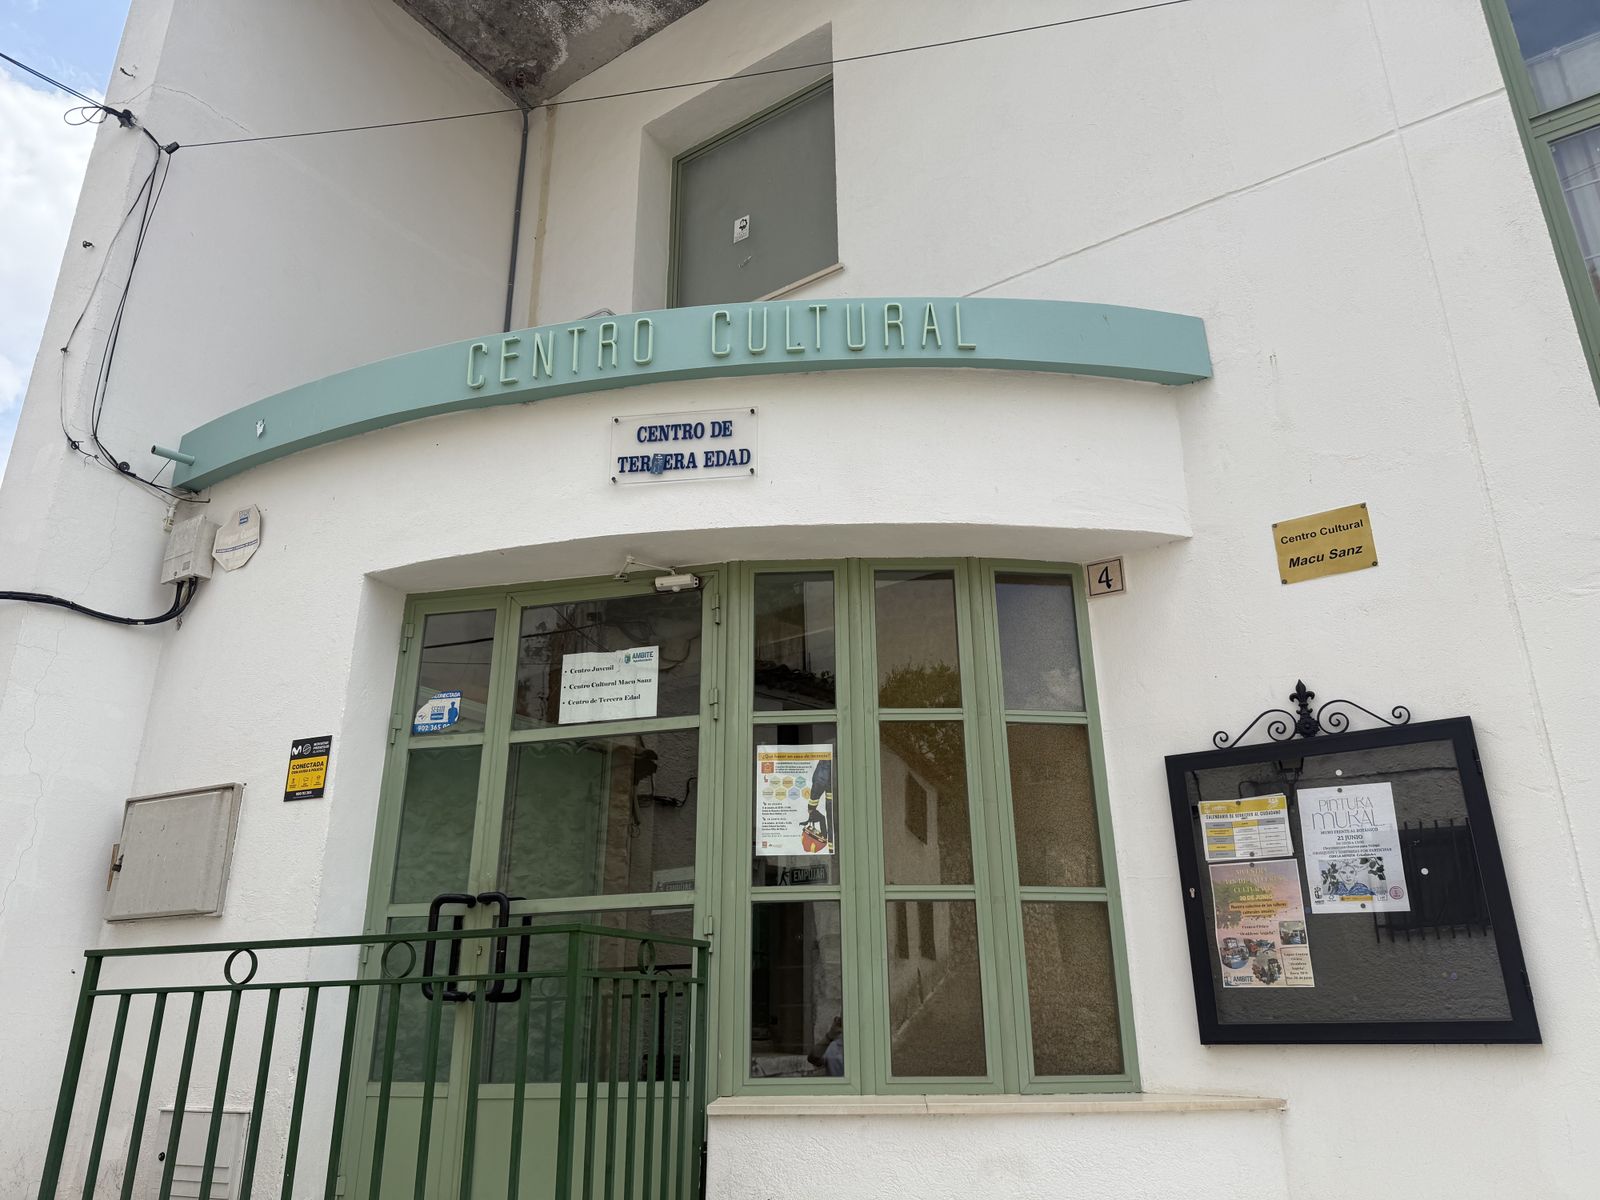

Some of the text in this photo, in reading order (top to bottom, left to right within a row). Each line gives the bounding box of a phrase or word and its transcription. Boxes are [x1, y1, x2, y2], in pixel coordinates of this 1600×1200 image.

[466, 302, 977, 389] CENTRO CULTURAL
[637, 420, 733, 443] CENTRO DE
[617, 448, 751, 474] TERERA EDAD
[1280, 519, 1364, 545] Centro Cultural
[1288, 545, 1363, 569] Macu Sanz
[1098, 566, 1113, 589] 4
[632, 650, 654, 659] AMBITE
[591, 664, 614, 672] Juvenil
[591, 680, 617, 688] Cultural
[292, 761, 325, 770] CONECTADA
[1318, 796, 1374, 812] PINTURA
[1312, 808, 1383, 830] MURAL
